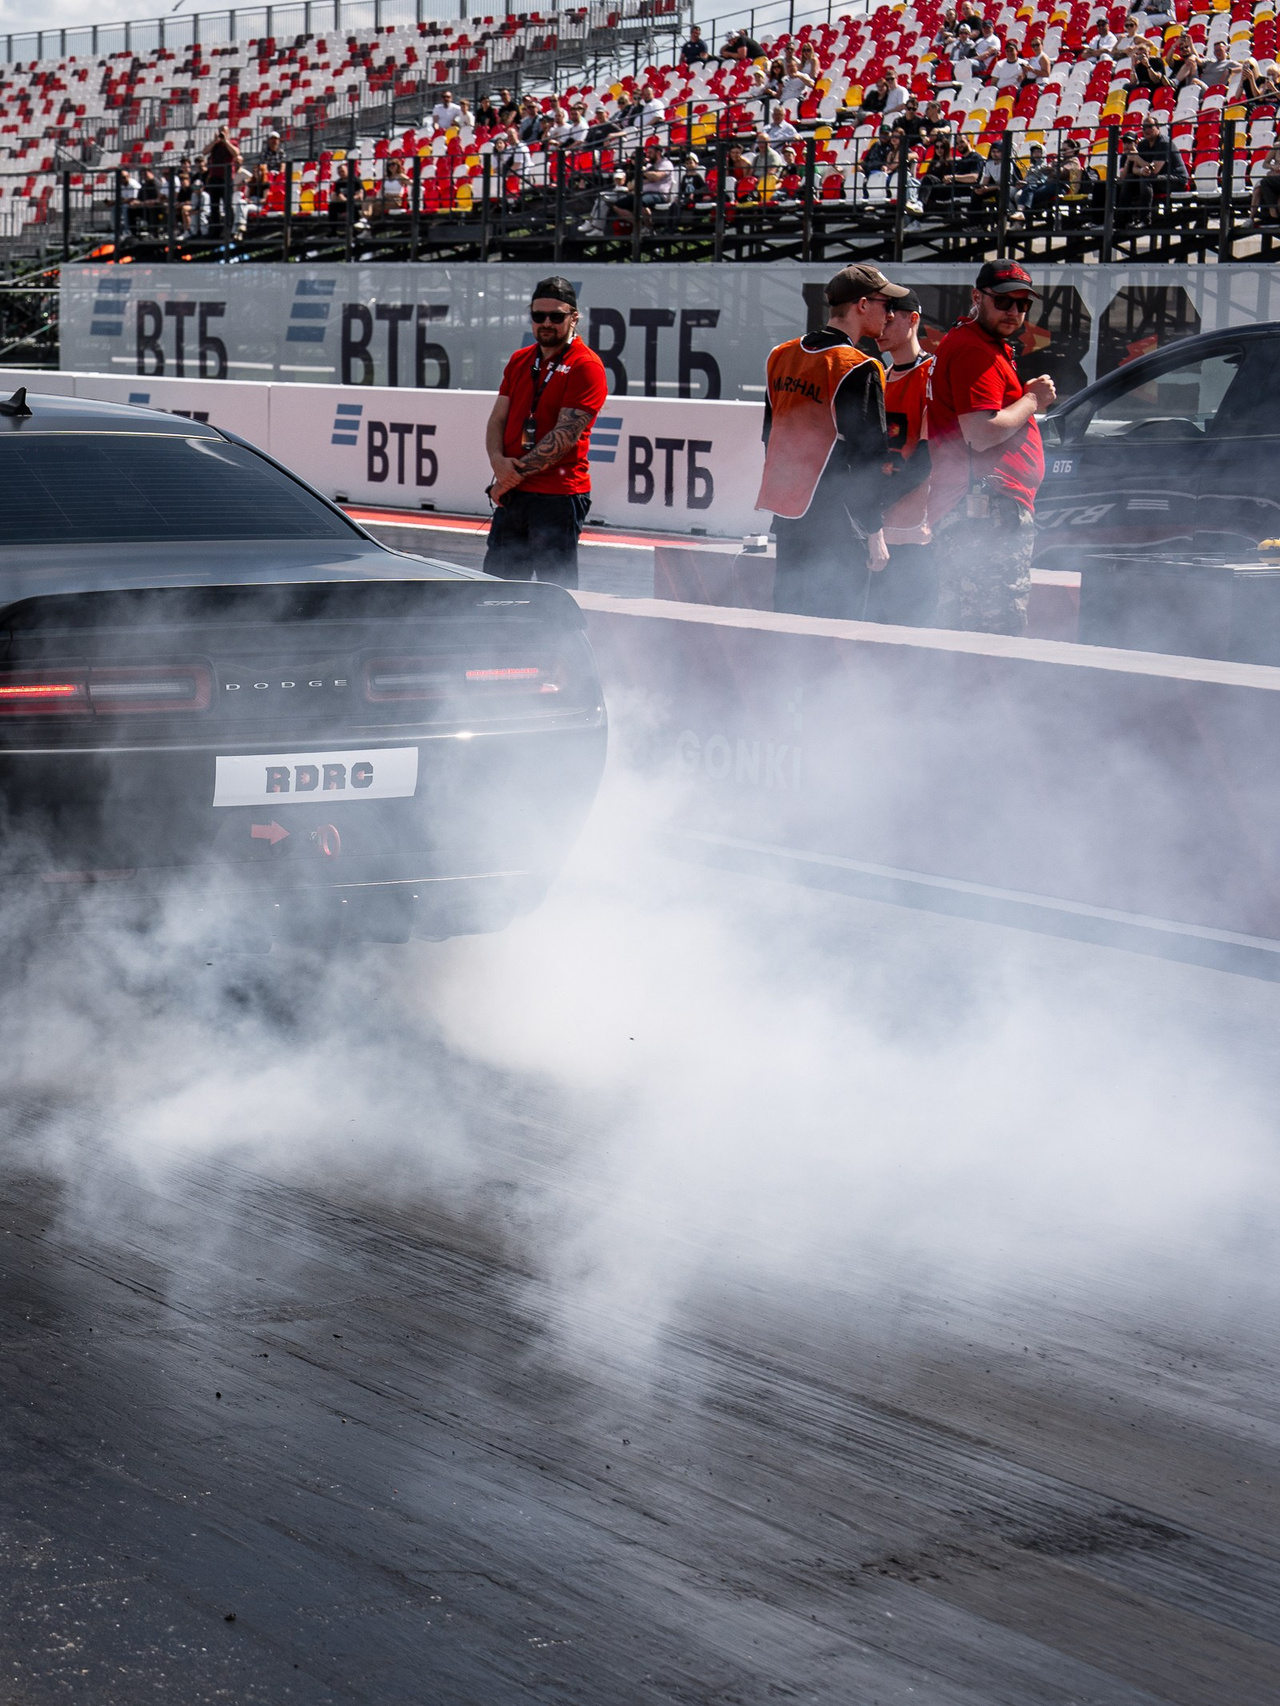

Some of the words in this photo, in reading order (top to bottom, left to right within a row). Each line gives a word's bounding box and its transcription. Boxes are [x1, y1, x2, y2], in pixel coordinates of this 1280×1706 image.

[136, 300, 228, 379] ВТБ
[341, 303, 450, 389] ВТБ
[588, 307, 721, 399] ВТБ
[367, 421, 439, 487] ВТБ
[628, 435, 715, 510] ВТБ
[1052, 460, 1073, 473] ВТБ
[225, 679, 348, 691] DODGE
[265, 761, 374, 794] RDRC
